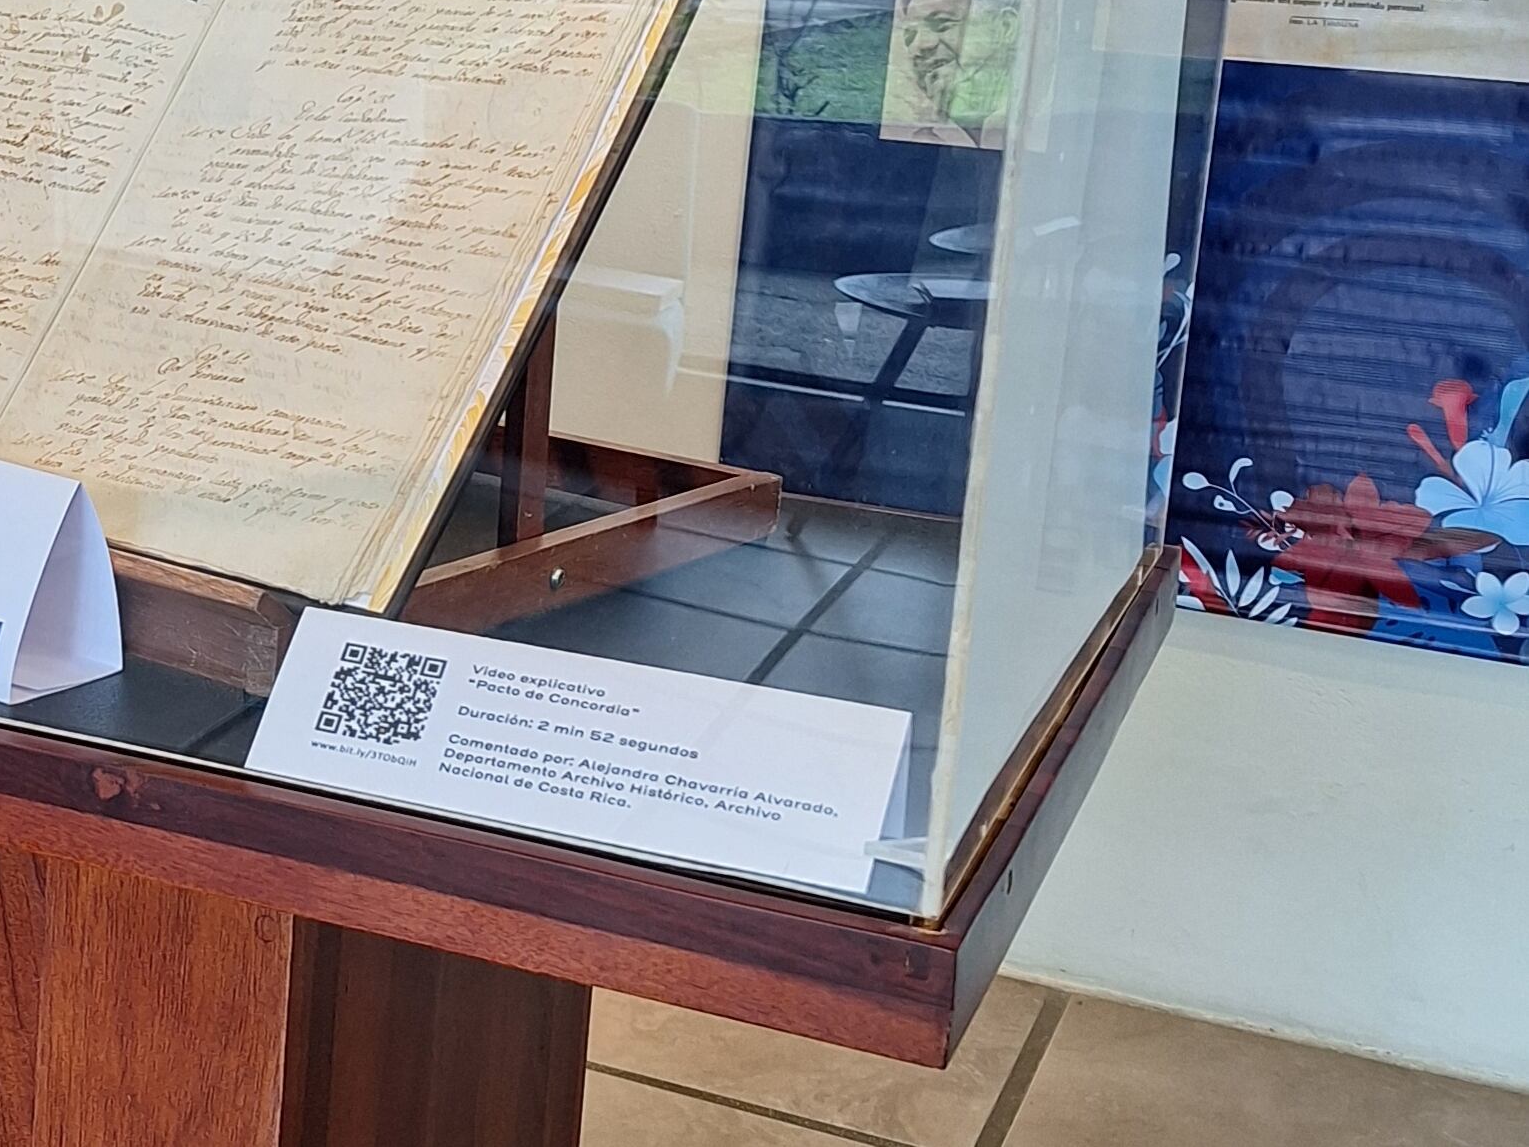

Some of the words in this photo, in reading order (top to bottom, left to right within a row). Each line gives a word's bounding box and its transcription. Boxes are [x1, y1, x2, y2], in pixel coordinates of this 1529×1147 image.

[519, 675, 606, 698] explicativo
[524, 689, 545, 701] de
[457, 705, 534, 729] Duración:
[536, 720, 550, 732] 2
[553, 725, 585, 738] min
[589, 729, 615, 744] 52
[618, 737, 699, 760] segundos
[438, 762, 510, 785] Nacional
[513, 777, 534, 790] de
[537, 781, 585, 800] Costa
[589, 790, 631, 809] Rica.
[443, 747, 557, 779] Departamento
[560, 770, 625, 792] Archivo
[629, 783, 709, 809] Histórico,
[713, 800, 782, 821] Archivo
[448, 733, 539, 760] Comentado
[541, 753, 575, 767] por:
[577, 758, 660, 782] Alejandra
[664, 774, 749, 800] Chavarría
[753, 791, 838, 817] Alvarado,
